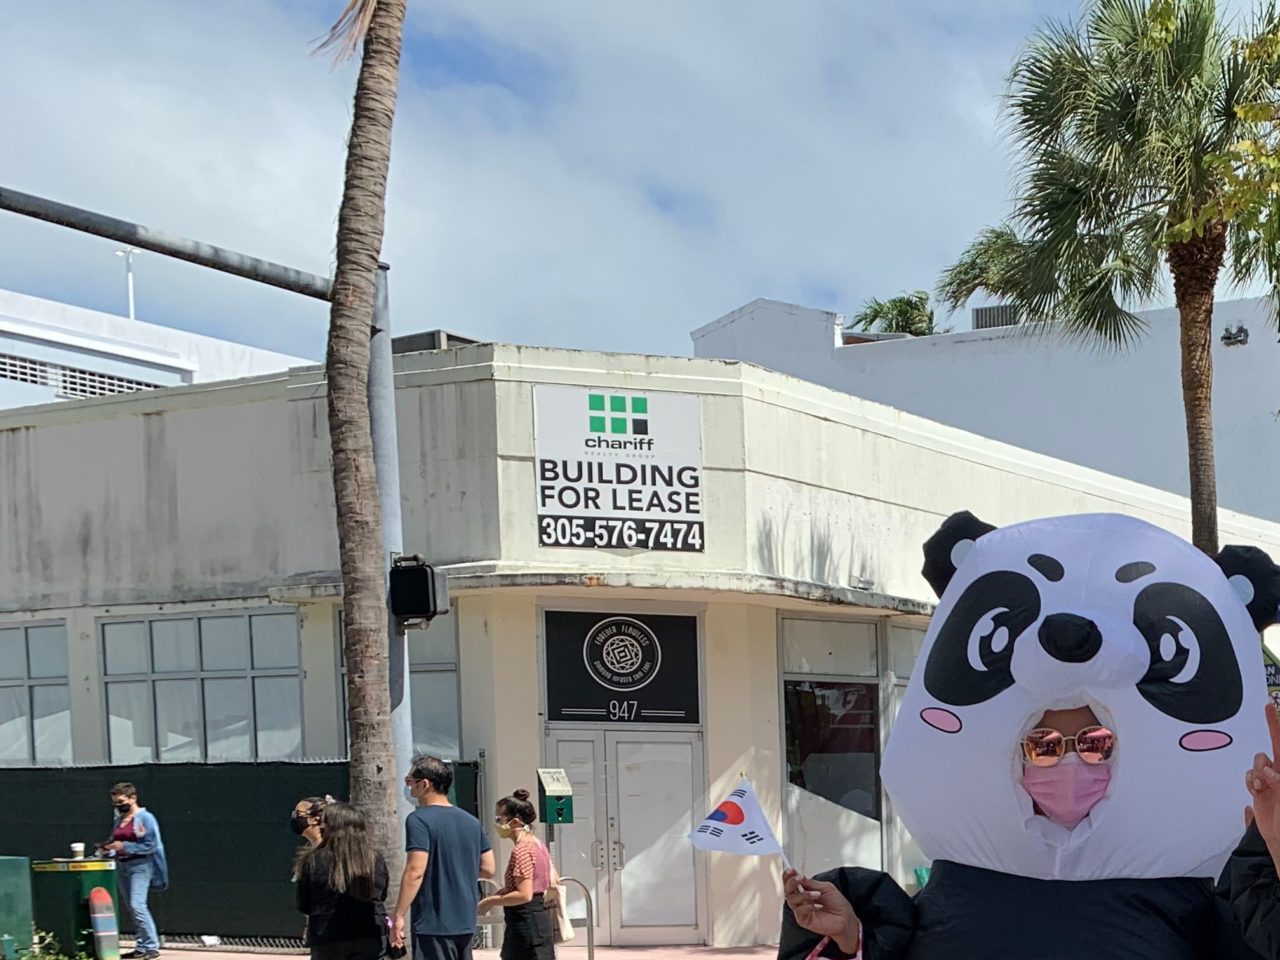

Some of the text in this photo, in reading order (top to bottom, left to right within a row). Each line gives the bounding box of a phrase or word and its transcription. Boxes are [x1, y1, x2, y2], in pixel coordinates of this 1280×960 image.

[584, 435, 655, 451] chariff
[539, 458, 700, 489] BUILDING
[540, 485, 701, 514] FOR LEASE
[541, 517, 703, 550] 305-576-7474
[609, 700, 638, 721] 947
